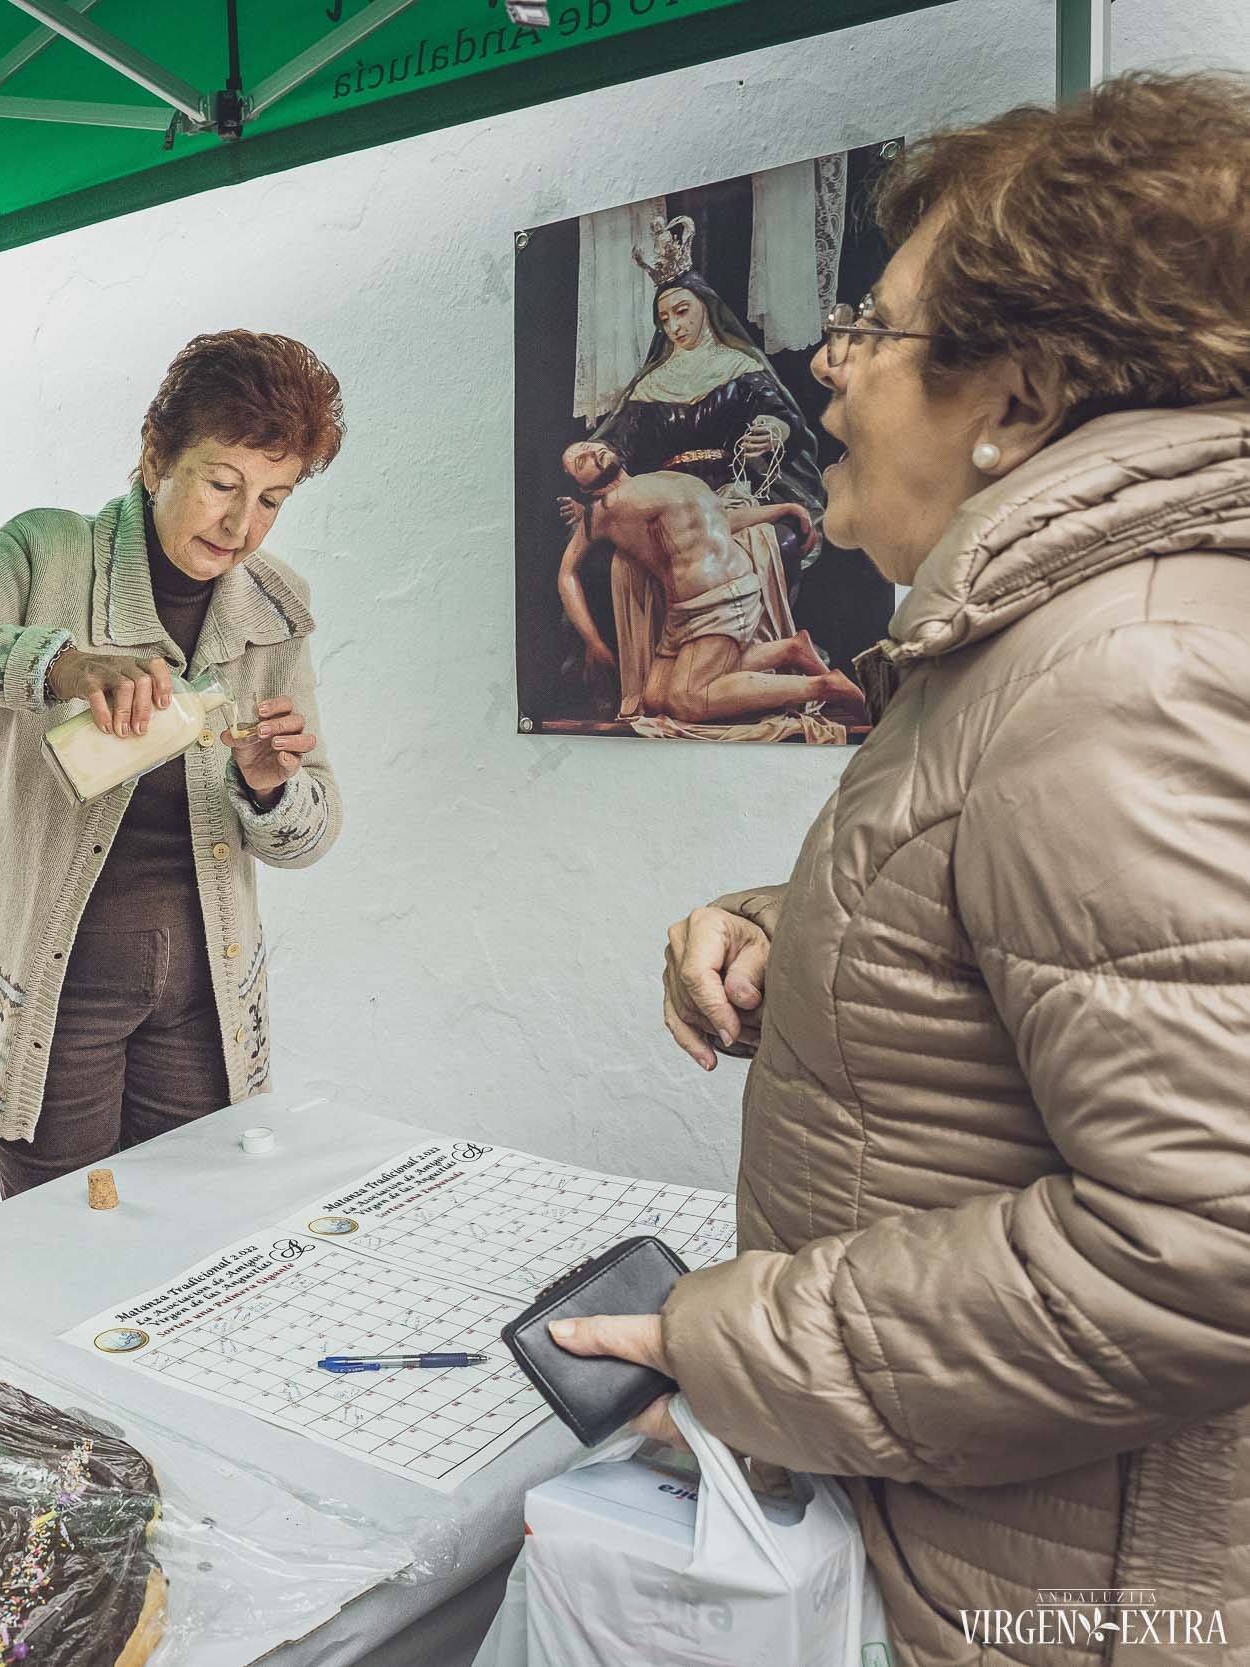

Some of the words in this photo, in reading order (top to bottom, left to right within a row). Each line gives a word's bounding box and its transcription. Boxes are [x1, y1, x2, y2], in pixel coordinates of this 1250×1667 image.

[323, 1188, 369, 1212] Matanza
[364, 1156, 420, 1189] Tradicional
[115, 1295, 170, 1322] Matanza
[167, 1256, 232, 1296] Tradicional
[146, 1307, 190, 1326] Virgen
[222, 1261, 273, 1290] Angustias
[226, 1254, 264, 1278] Amigos
[156, 1319, 193, 1337] Sortea
[192, 1307, 215, 1320] una
[213, 1283, 258, 1307] Palmera
[256, 1262, 295, 1284] Gigante
